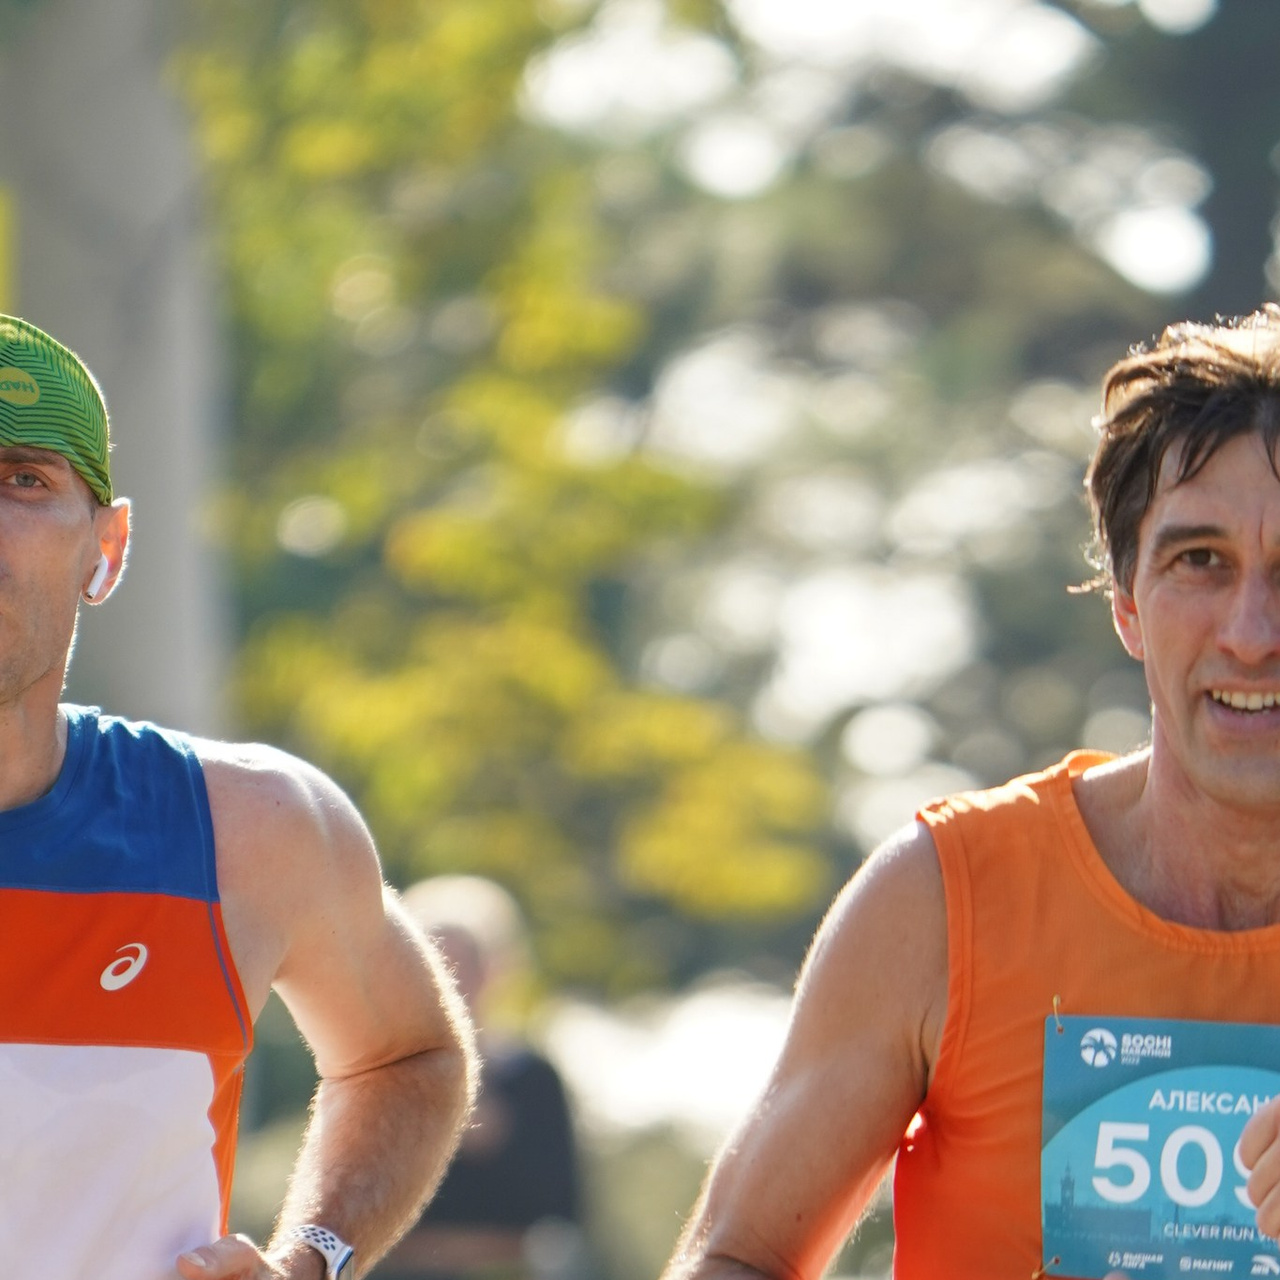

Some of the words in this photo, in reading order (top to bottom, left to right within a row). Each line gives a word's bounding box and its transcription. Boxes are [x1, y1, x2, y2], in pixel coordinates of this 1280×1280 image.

[1149, 1088, 1271, 1115] АЛЕКСАН
[1164, 1222, 1220, 1239] CLEVER
[1223, 1225, 1254, 1241] RUN
